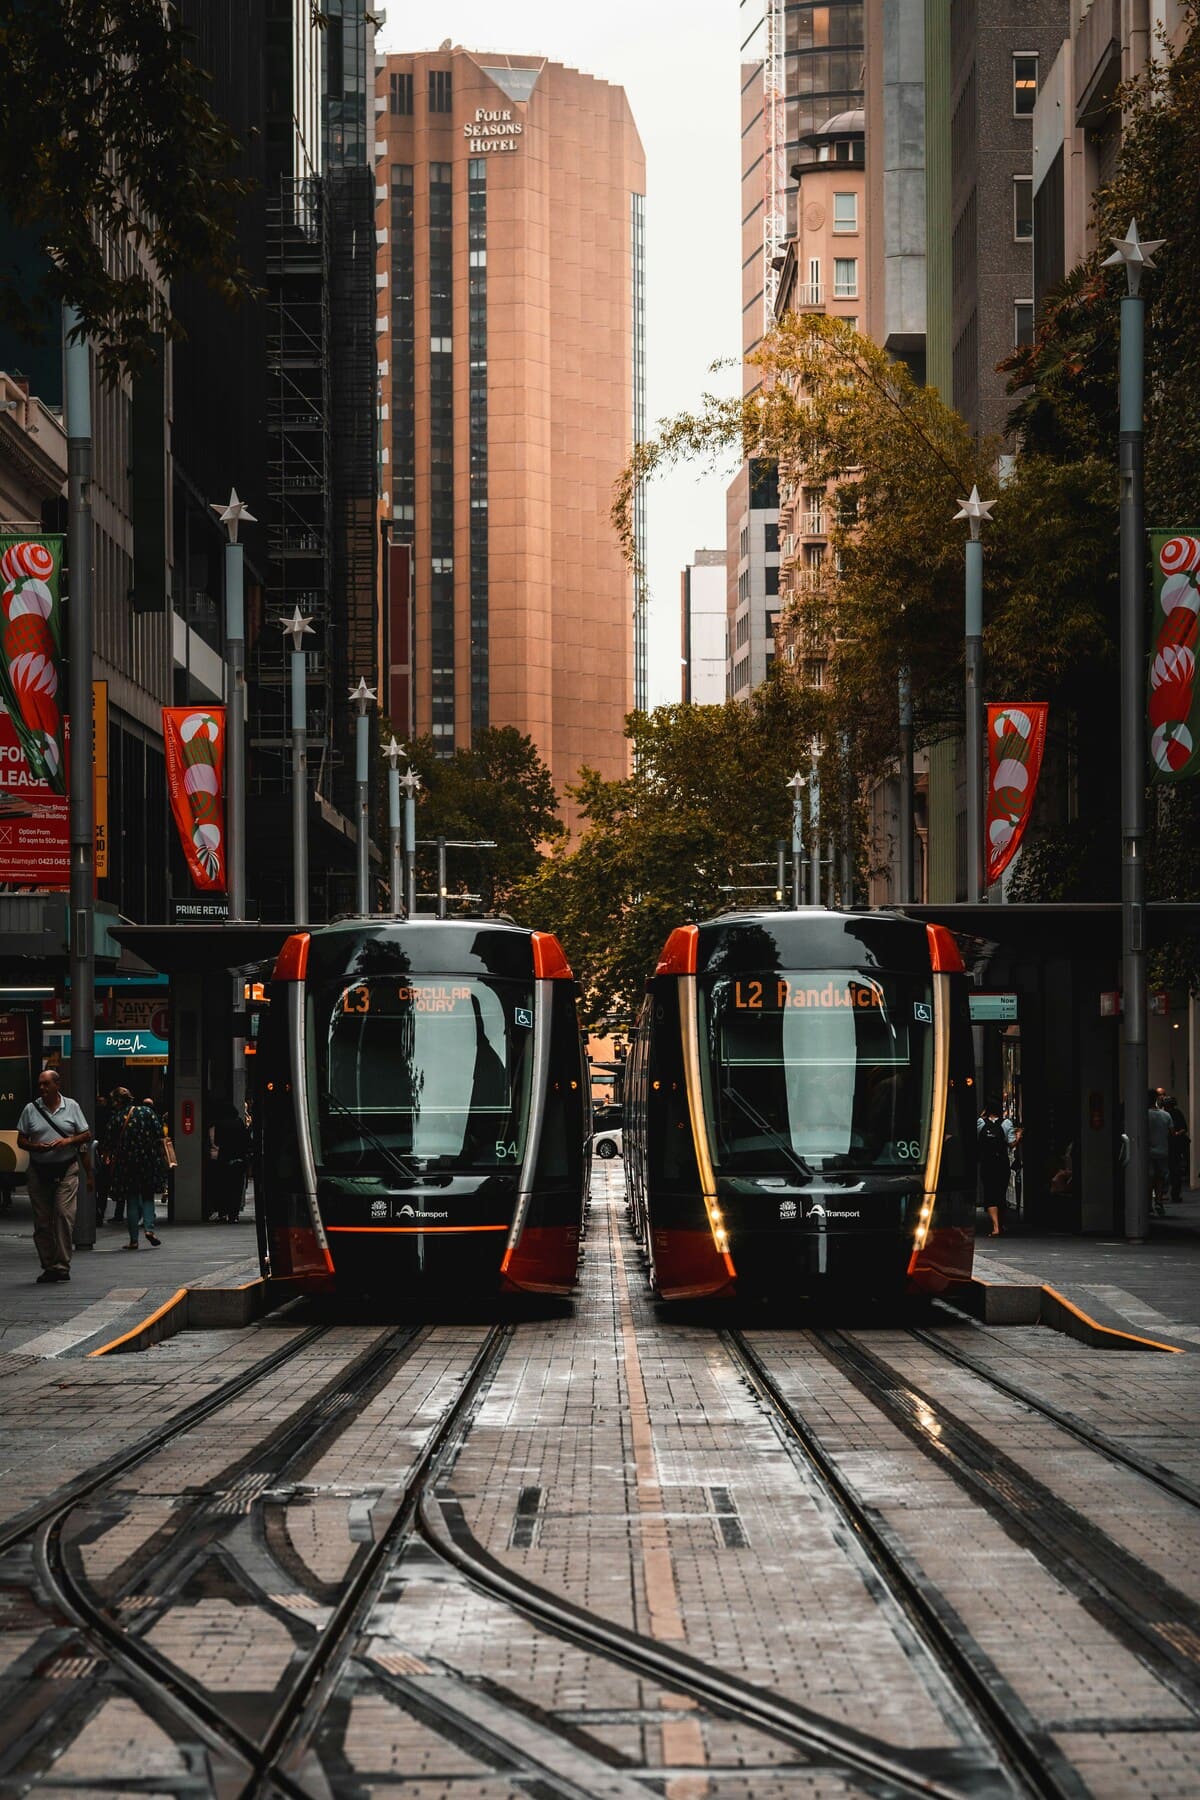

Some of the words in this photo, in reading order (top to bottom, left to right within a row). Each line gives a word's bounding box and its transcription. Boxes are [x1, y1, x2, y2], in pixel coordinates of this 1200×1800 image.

[475, 108, 512, 122] FOUR
[463, 122, 523, 137] SEASONS
[469, 139, 518, 153] HOTEL
[176, 905, 202, 915] PRIME
[343, 985, 371, 1013] L3
[398, 987, 472, 1000] CIRCULAR
[735, 980, 764, 1009] L2
[777, 979, 884, 1008] Randwick
[416, 999, 456, 1012] QUAY
[106, 1036, 131, 1047] Bupa
[495, 1140, 519, 1158] 54
[896, 1140, 921, 1159] 36
[414, 1210, 448, 1219] Transport
[779, 1210, 797, 1218] NSW
[825, 1210, 861, 1219] Transport
